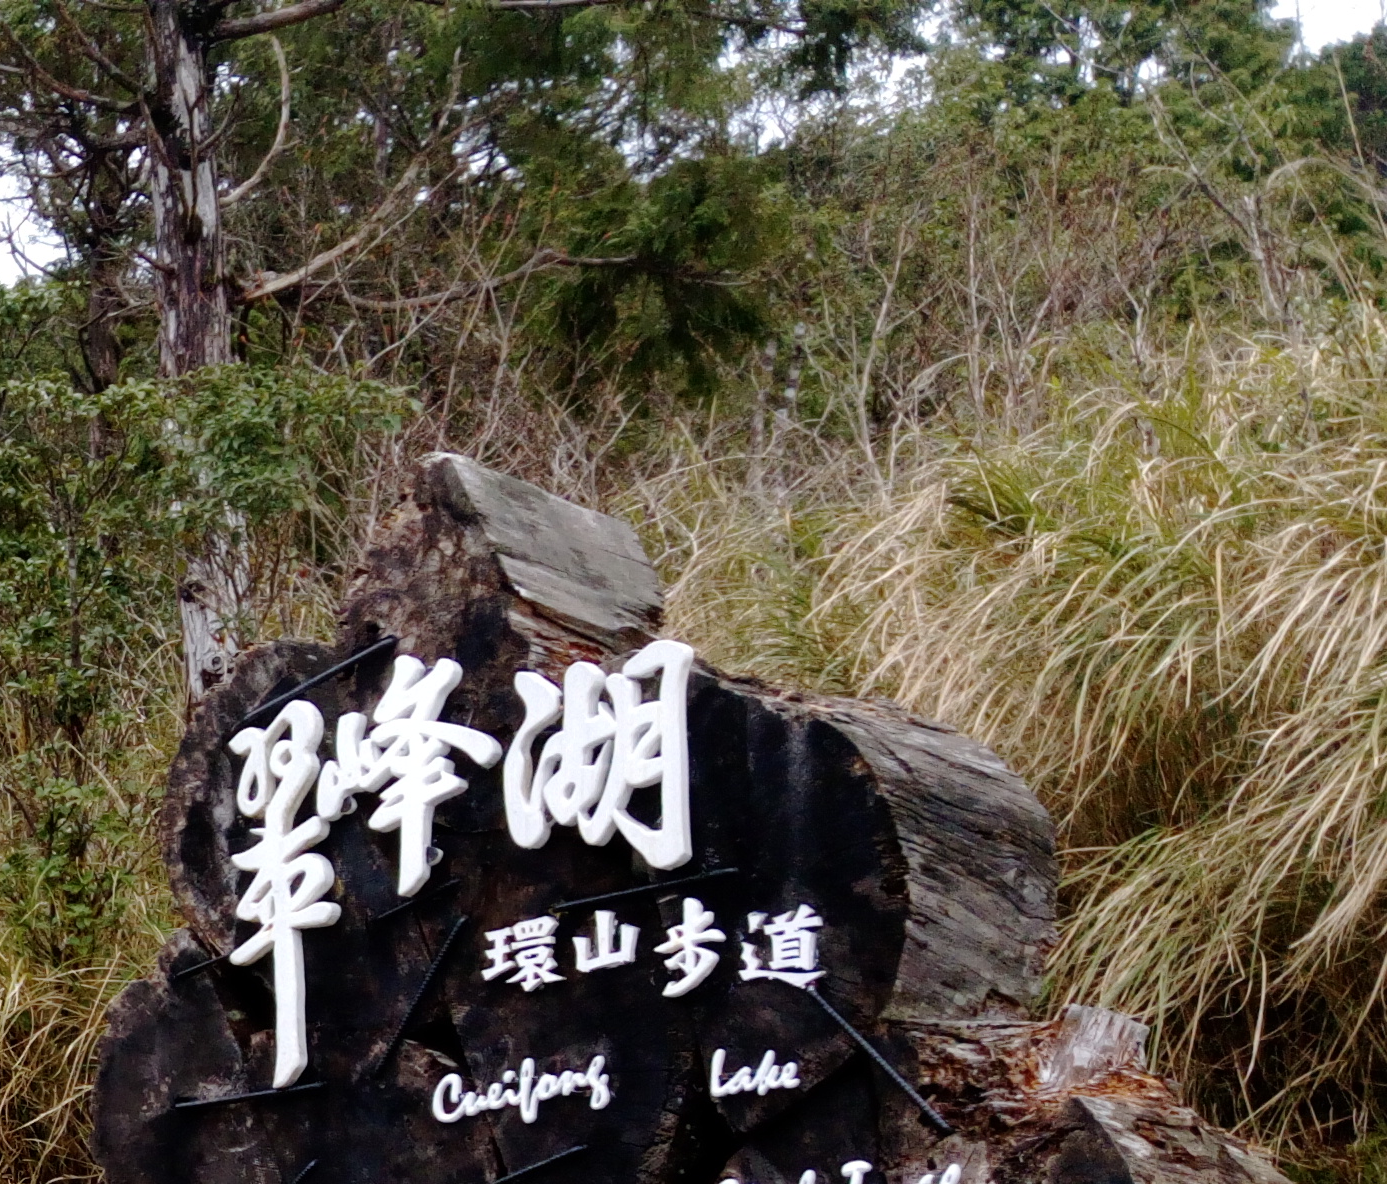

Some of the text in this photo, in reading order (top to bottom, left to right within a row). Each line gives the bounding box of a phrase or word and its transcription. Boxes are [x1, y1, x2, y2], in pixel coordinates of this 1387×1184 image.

[481, 897, 827, 997] 環山步道
[432, 1048, 800, 1124] Cueifong Lake
